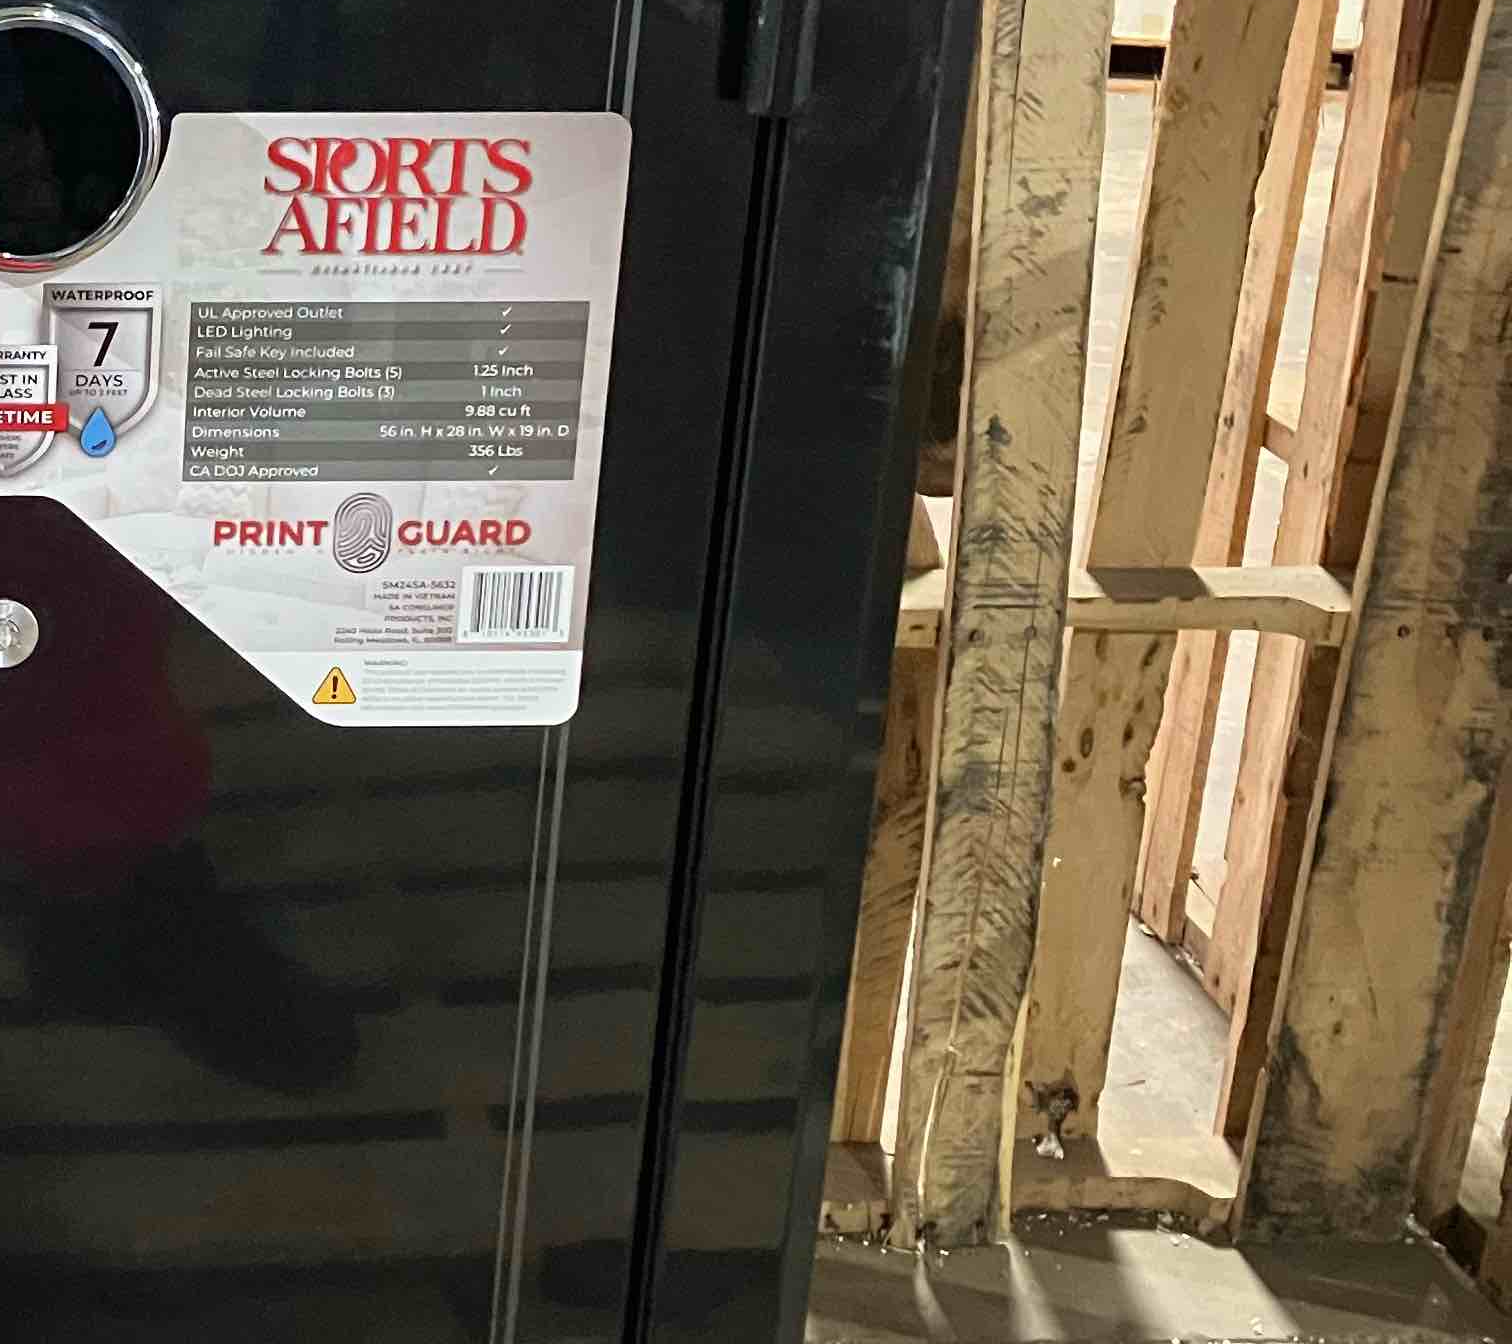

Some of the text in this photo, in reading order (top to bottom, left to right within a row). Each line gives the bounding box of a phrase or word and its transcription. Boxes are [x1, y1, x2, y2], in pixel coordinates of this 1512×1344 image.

[263, 135, 533, 198] SPORTS
[260, 194, 529, 257] AFIELD
[51, 289, 155, 302] WATERPROOF
[198, 307, 343, 321] UL Approved Outlet
[197, 325, 293, 340] LED Lighting
[87, 321, 119, 367] 7
[196, 346, 221, 359] Fail
[224, 346, 257, 359] Safe
[260, 346, 287, 361] Key
[193, 366, 403, 381] Active Steel Locking Bolts (5)
[501, 364, 534, 377] Inch
[22, 374, 38, 385] IN
[76, 374, 123, 387] DAYS
[194, 386, 232, 399] Dead
[235, 386, 272, 399] Steel
[276, 386, 334, 401] Locking
[338, 385, 374, 398] Bolts
[481, 385, 522, 398] 1 Inch
[192, 406, 307, 418] Interior Volume
[464, 404, 531, 417] 9.88 cu ft
[191, 425, 281, 439] Dimensions
[379, 425, 398, 438] 56
[400, 425, 417, 438] in.
[421, 425, 433, 437] H
[436, 428, 445, 437] x
[447, 425, 465, 438] 28
[468, 425, 483, 437] in.
[488, 425, 506, 437] W
[508, 428, 516, 437] x
[519, 424, 534, 437] 19
[558, 424, 570, 437] D
[190, 445, 245, 459] Weight
[468, 444, 523, 457] 356 Lbs
[189, 464, 319, 480] CA DOJ Approved
[213, 519, 533, 547] PRINT GUARD
